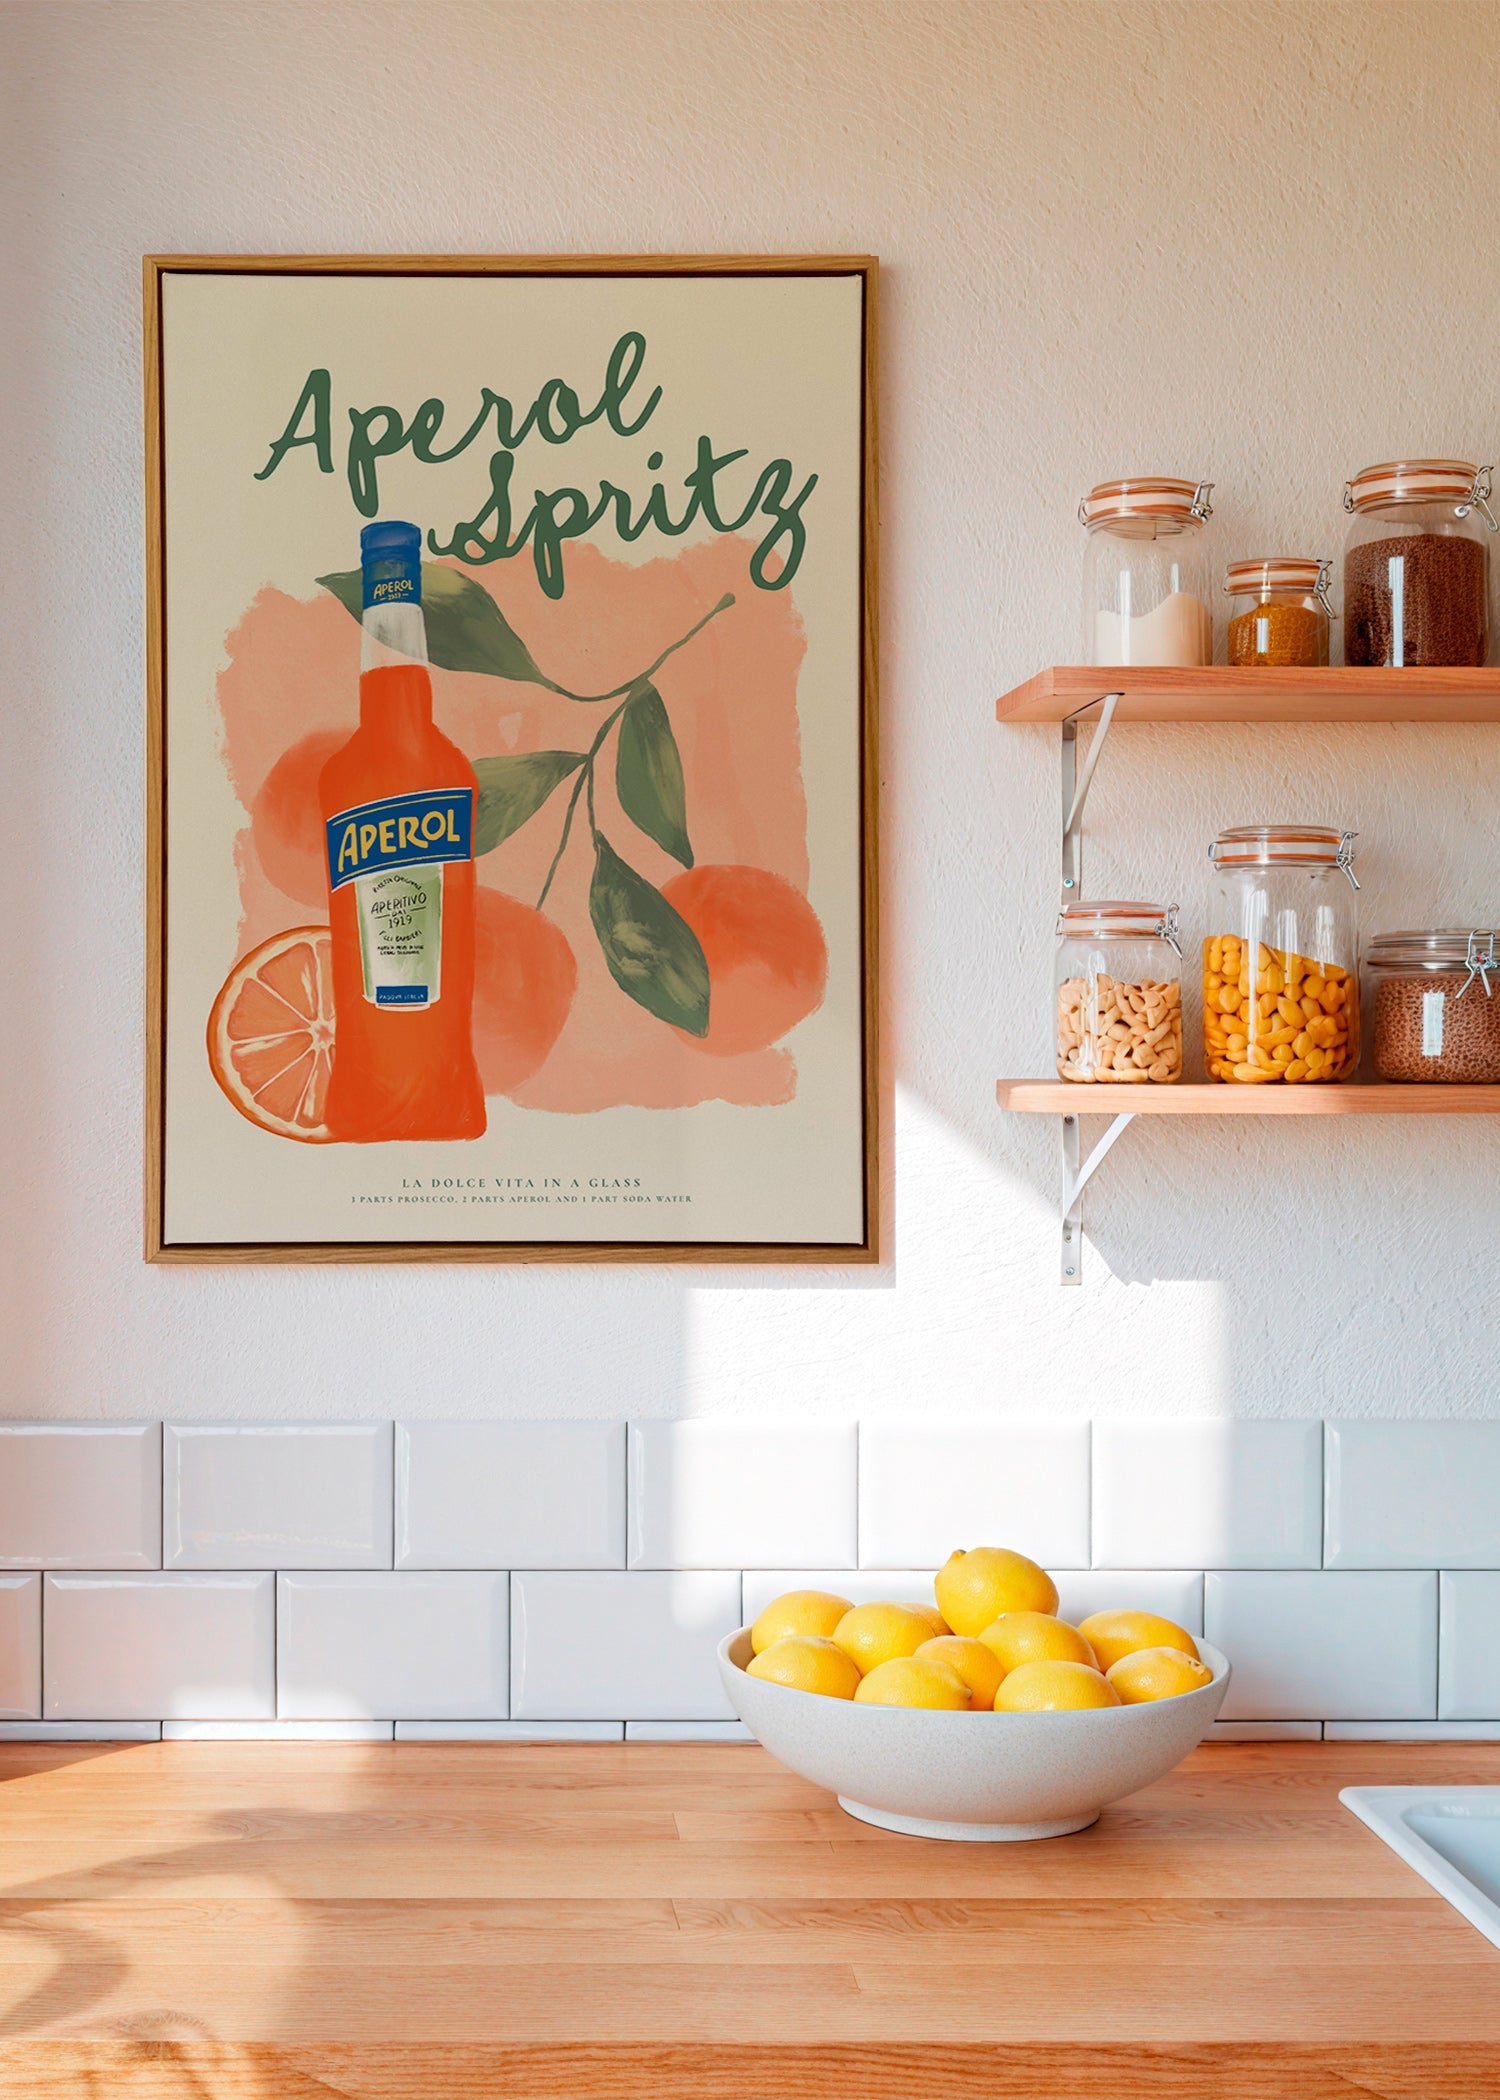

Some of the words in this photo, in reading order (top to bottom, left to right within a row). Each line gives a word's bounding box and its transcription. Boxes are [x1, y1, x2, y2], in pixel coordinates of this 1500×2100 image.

[253, 331, 663, 518] Aperol
[427, 435, 819, 600] Spritz
[373, 579, 414, 600] APEROL
[338, 809, 460, 872] APEROL
[370, 892, 427, 914] APERITIVO
[402, 1178, 422, 1189] LA
[431, 1178, 487, 1189] DOLCE
[495, 1178, 535, 1189] VITA
[544, 1178, 561, 1189] IN
[570, 1178, 580, 1189] A
[589, 1178, 641, 1189] GLASS
